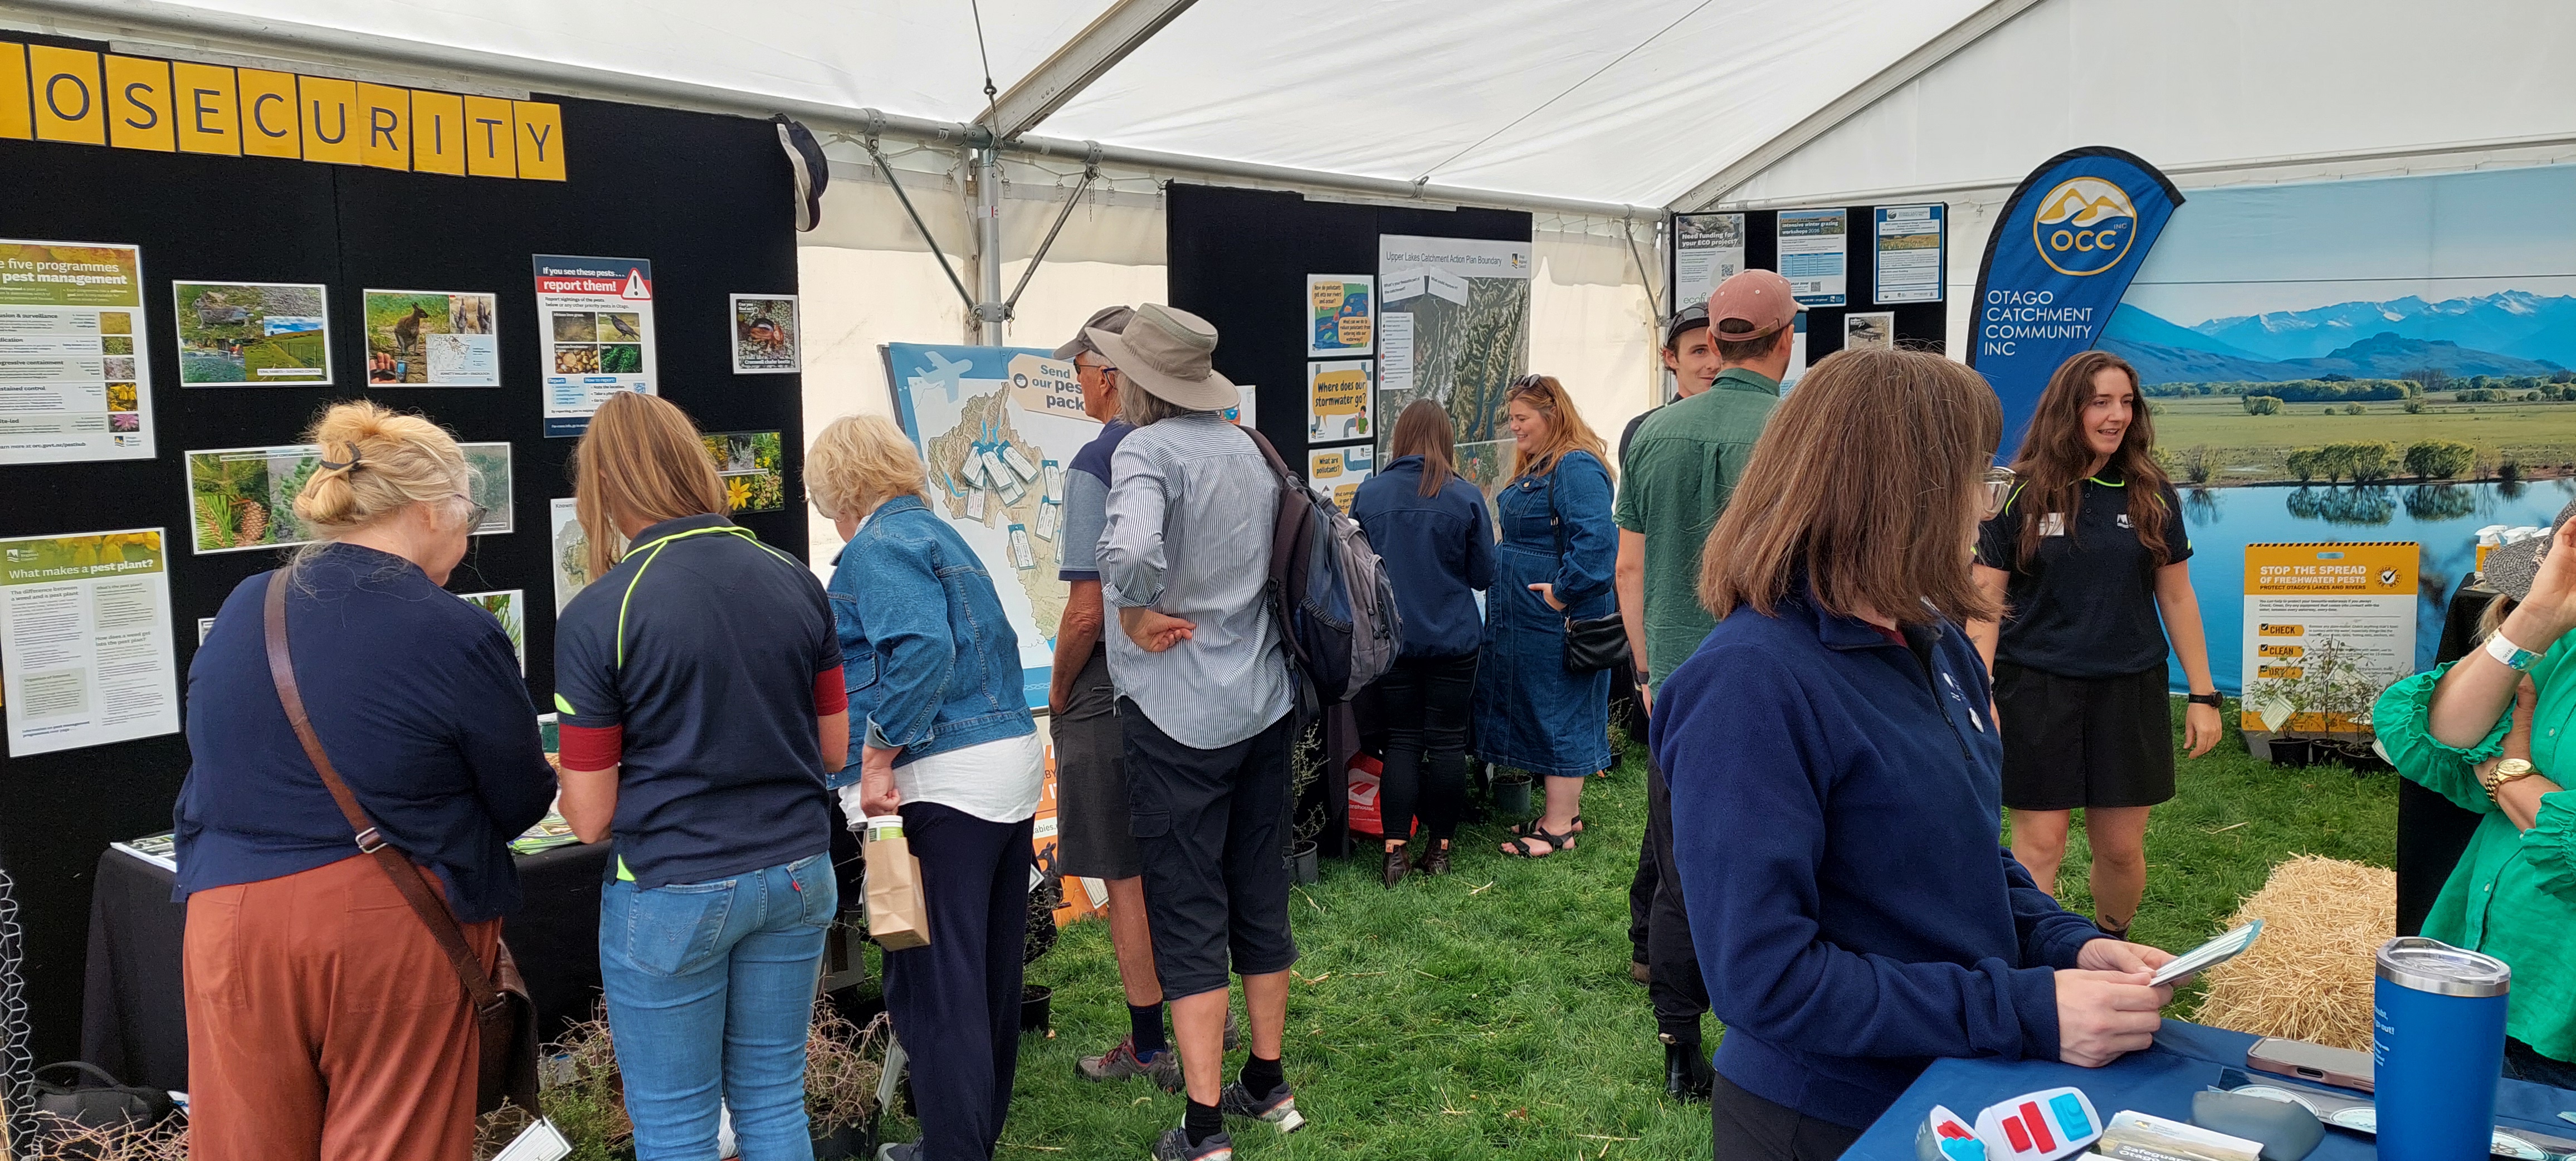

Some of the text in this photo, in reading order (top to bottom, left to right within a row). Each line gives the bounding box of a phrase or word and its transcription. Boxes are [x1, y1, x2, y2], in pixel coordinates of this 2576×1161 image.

[2051, 230, 2116, 251] OCC
[8, 258, 33, 269] five
[37, 261, 119, 272] programmes
[1387, 251, 1502, 266] Upper Lakes Catchment Action Plan Boundary
[2, 272, 128, 285] pest management
[543, 280, 616, 292] report them!
[1988, 290, 2053, 305] OTAGO
[1987, 308, 2093, 323] CATCHMENT
[1985, 325, 2093, 340] COMMUNITY
[1984, 342, 2016, 356] INC
[1041, 364, 1070, 379] Send
[1032, 379, 1082, 394] our pes
[1318, 382, 1339, 393] Where
[1340, 380, 1354, 391] does
[1046, 395, 1085, 411] pack
[1315, 393, 1366, 407] stormwater go?
[1316, 465, 1340, 476] pollutants?
[9, 570, 40, 579] What
[42, 566, 79, 577] makes
[90, 563, 116, 574] pest
[117, 559, 154, 572] plant?
[2260, 565, 2367, 574] STOP THE SPREAD
[2381, 1024, 2394, 1035] out!
